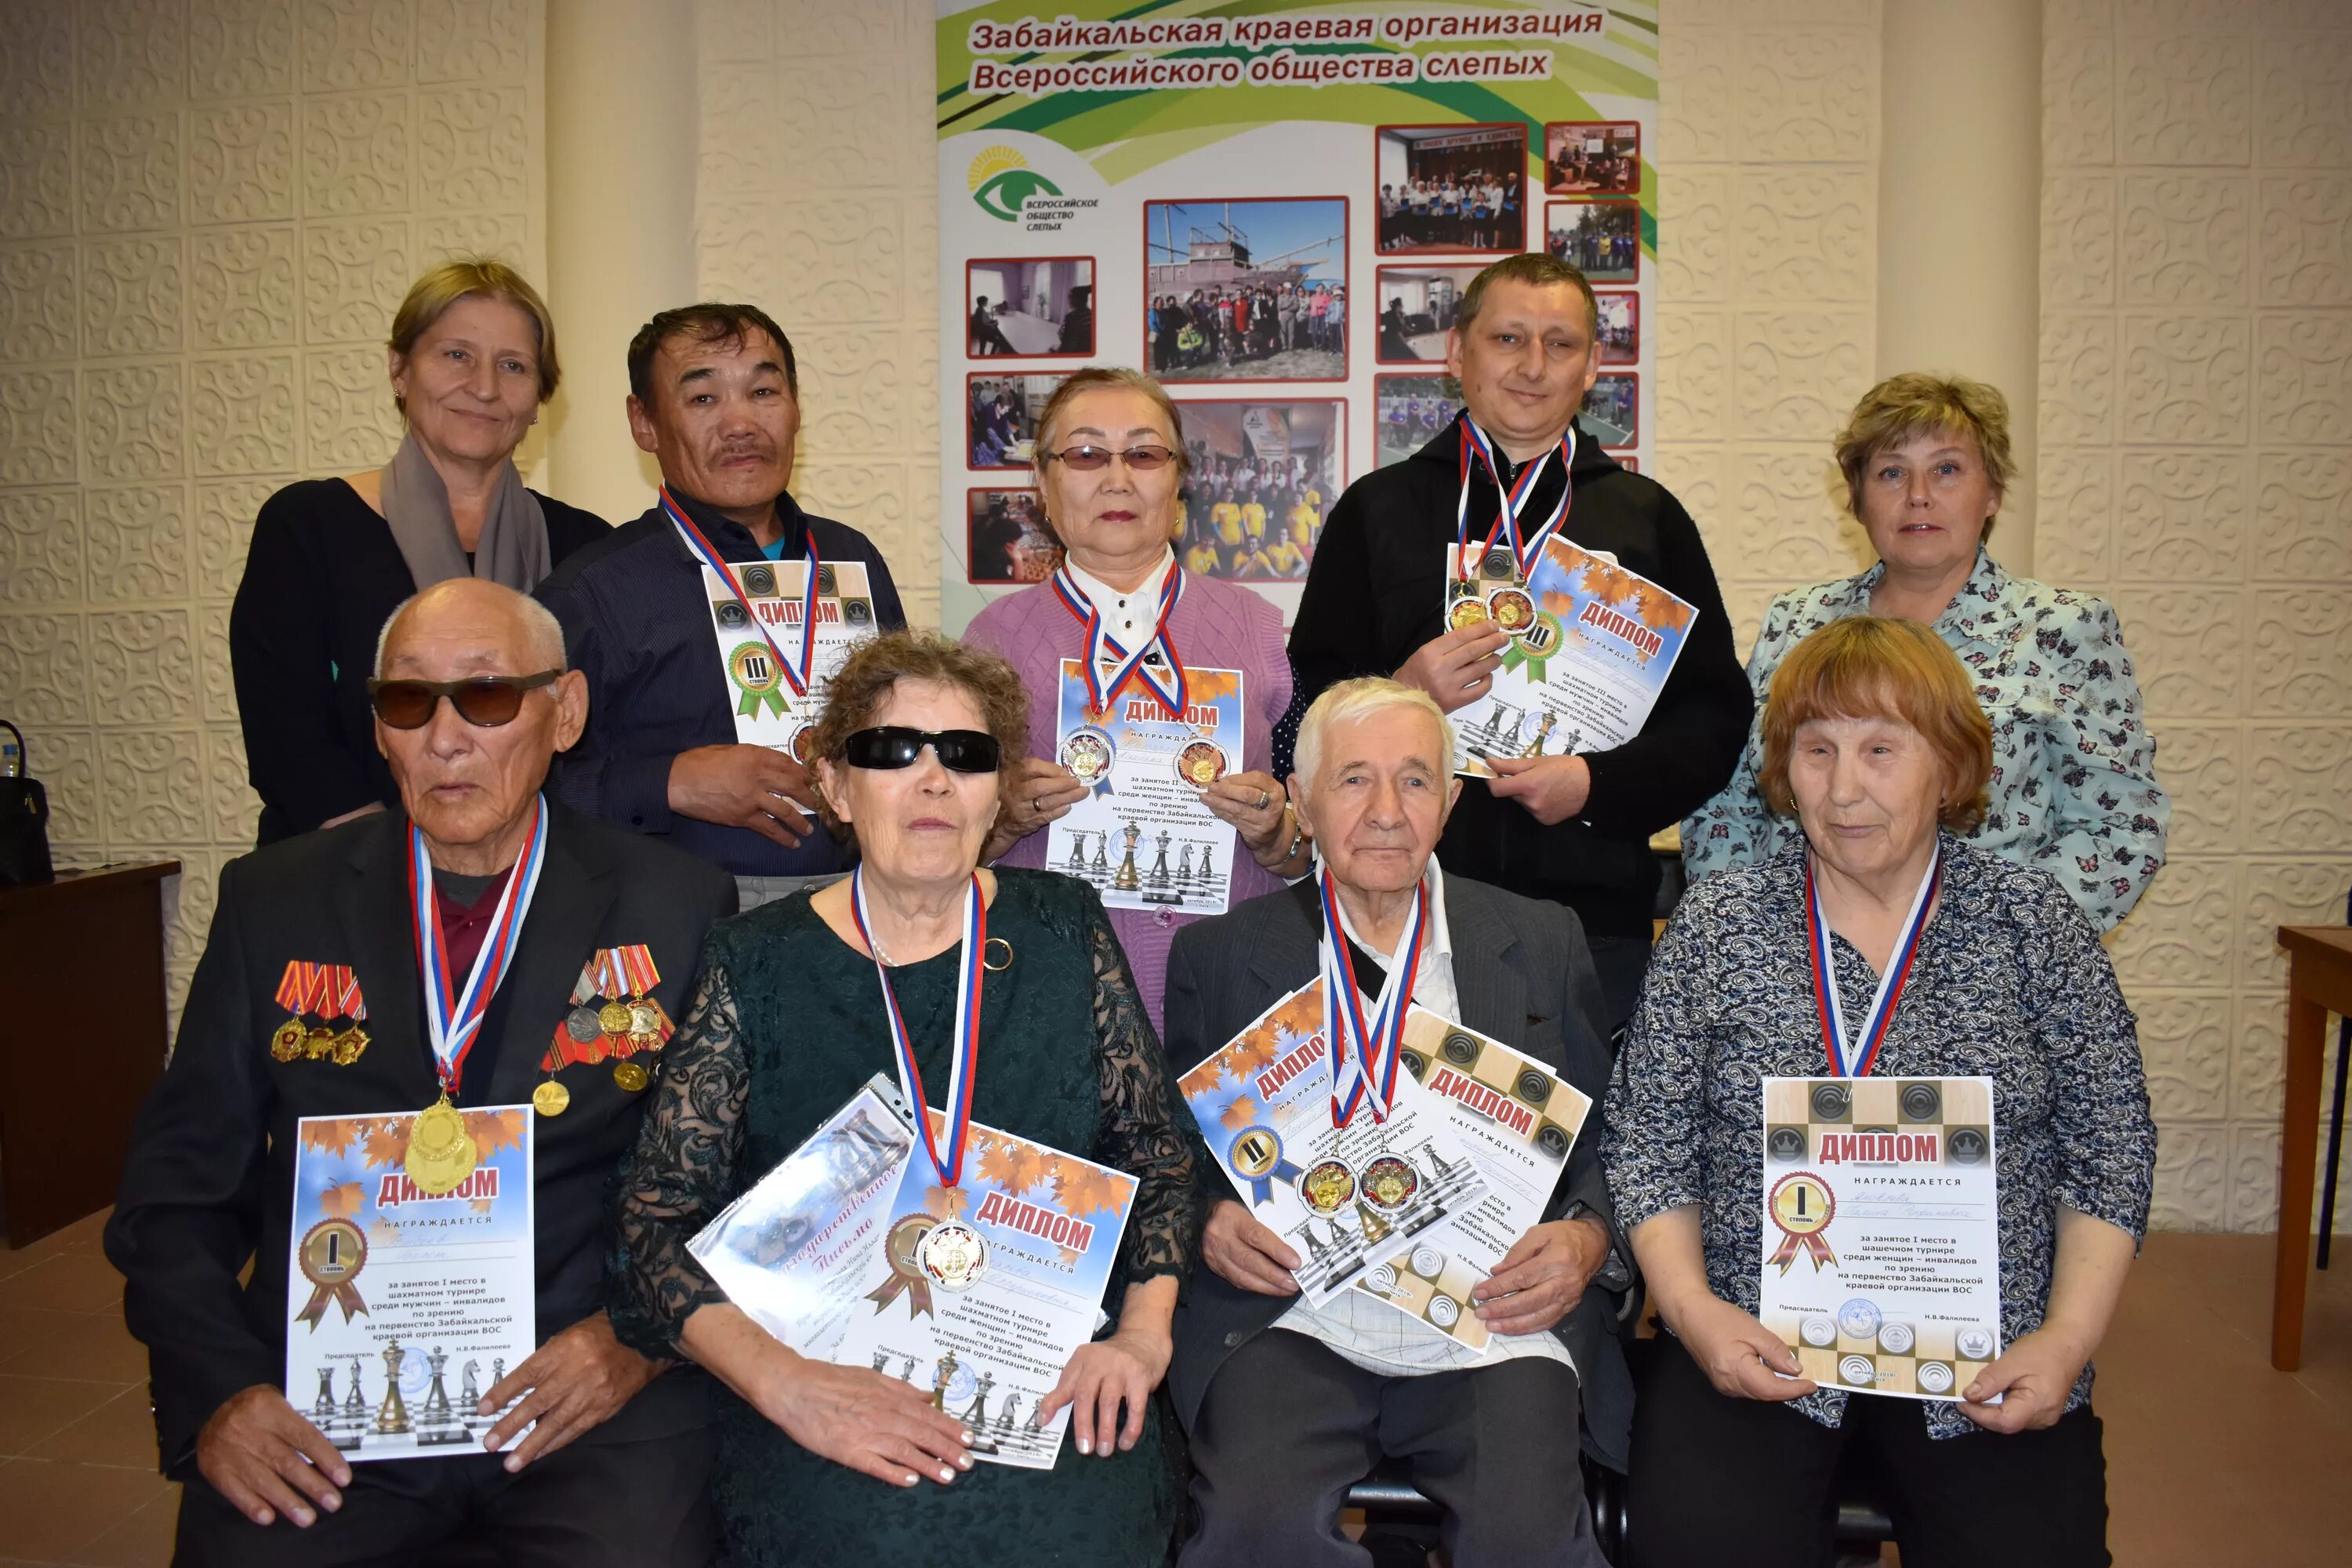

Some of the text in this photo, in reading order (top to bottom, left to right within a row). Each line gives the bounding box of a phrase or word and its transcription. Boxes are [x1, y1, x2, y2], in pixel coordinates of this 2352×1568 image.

[973, 14, 1602, 49] Забайкальская краевая организация
[975, 55, 1548, 93] Всероссийского общества слепых
[1027, 198, 1098, 209] ВСЕРОССИЙСКОЕ
[1027, 212, 1074, 220] ОБЩЕСТВО
[1027, 223, 1062, 231] СЛЕПЫХ
[1581, 603, 1662, 655] ДИПЛОМ
[1578, 633, 1646, 671] НАГРАЖДАЕТСЯ
[745, 658, 768, 678] III
[1549, 681, 1628, 726] среди мужчин инвалидов
[1563, 680, 1622, 713] шахматном турнире
[1571, 676, 1595, 690] занятое
[1606, 694, 1623, 706] место
[1541, 701, 1617, 744] краевой организации ВОС
[1548, 696, 1584, 716] первенство
[1585, 713, 1625, 741] Забайкальской
[1582, 705, 1604, 719] зрению
[1352, 1102, 1370, 1114] мест
[1428, 1068, 1534, 1134] ДИПЛОМ
[1351, 1126, 1379, 1145] зрению
[1399, 1122, 1414, 1134] ВОС
[1241, 1138, 1265, 1163] II
[1450, 1116, 1534, 1167] НАГРАЖДАЕТСЯ
[1820, 1134, 1937, 1164] ДИПЛОМ
[1482, 1200, 1504, 1217] рнире
[1489, 1195, 1504, 1207] есто
[1798, 1187, 1806, 1214] I
[383, 1217, 491, 1229] НАГРАЖДАЕТСЯ
[975, 1192, 1093, 1251] ДИПЛОМ
[1456, 1214, 1508, 1250] Забайкальско
[1473, 1207, 1515, 1235] инвалидов
[328, 1233, 339, 1265] I
[1488, 1243, 1502, 1256] ВОС
[1909, 1275, 1983, 1283] Забайкальской
[447, 1288, 485, 1297] турнире
[379, 1321, 434, 1330] первенство
[438, 1317, 512, 1326] Забайкальской
[427, 1309, 464, 1318] зрению
[960, 1305, 1047, 1337] шахматном турнире
[975, 1299, 1009, 1314] занятое
[1018, 1313, 1043, 1325] место
[372, 1331, 412, 1341] краевой
[416, 1329, 478, 1338] организации
[941, 1309, 1063, 1352] среди женщин инвалидов
[943, 1330, 993, 1350] первенство
[989, 1334, 1022, 1349] зрению
[877, 1344, 924, 1363] Председатель
[934, 1338, 1051, 1377] краевой организации ВОС
